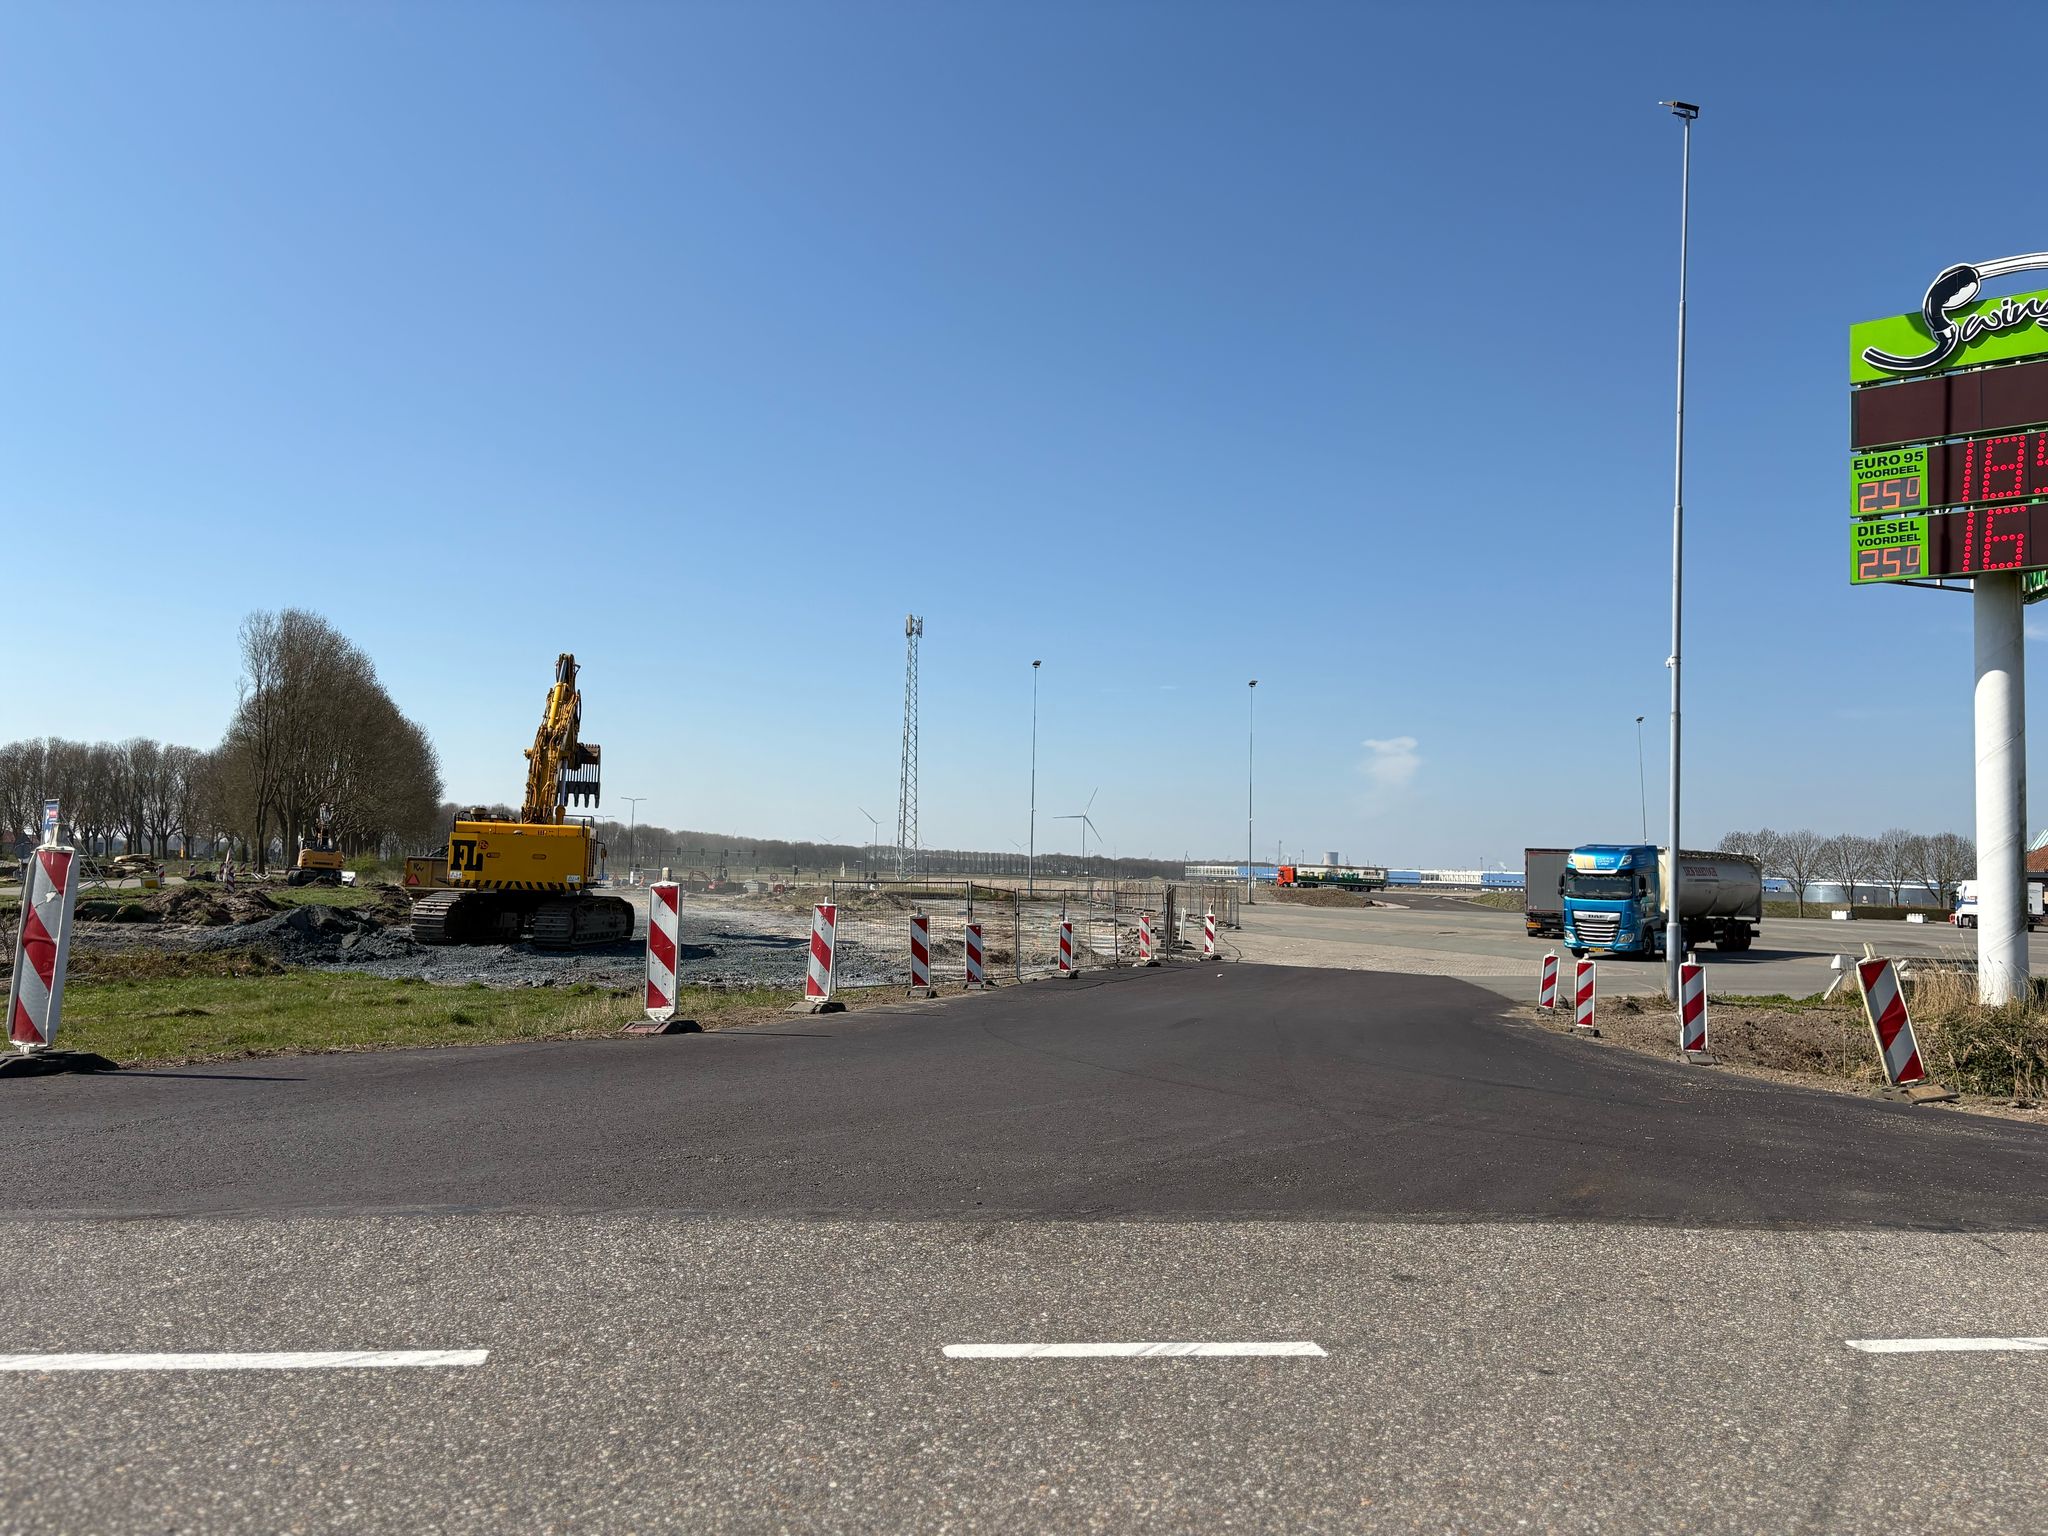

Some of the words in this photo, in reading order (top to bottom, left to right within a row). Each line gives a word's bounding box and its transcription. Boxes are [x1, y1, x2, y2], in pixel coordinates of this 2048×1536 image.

[1853, 453, 1901, 471] EURO
[1903, 450, 1924, 464] 95
[1857, 465, 1921, 480] VOORDEEL
[1857, 520, 1920, 538] DIESEL
[1857, 533, 1921, 548] VOORDEEL
[450, 839, 484, 872] FL
